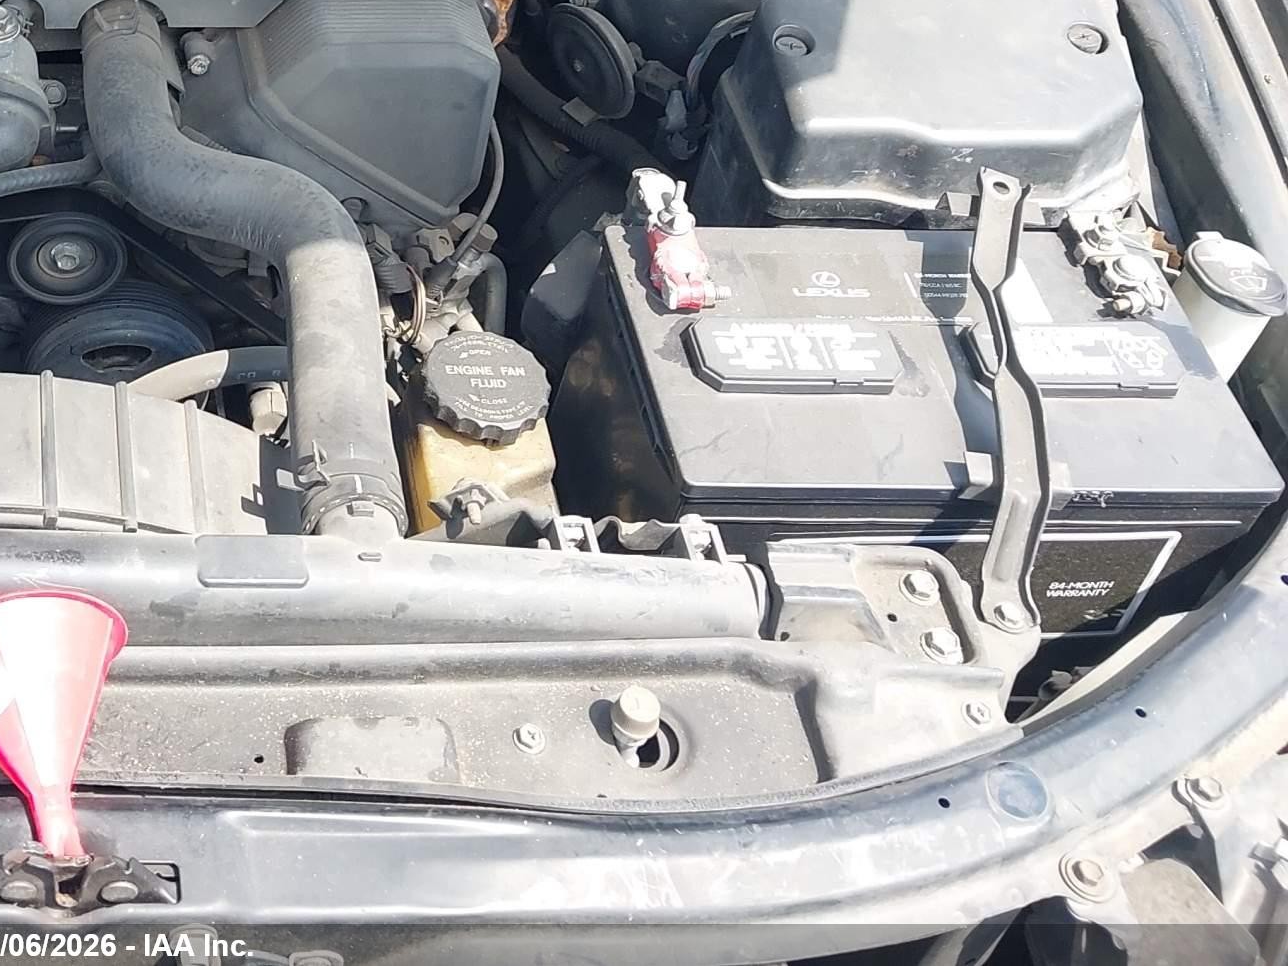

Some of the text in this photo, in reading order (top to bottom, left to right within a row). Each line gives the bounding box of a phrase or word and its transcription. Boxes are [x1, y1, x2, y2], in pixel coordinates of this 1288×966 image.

[792, 287, 872, 298] LEXUS
[445, 365, 526, 377] ENGINE FAN
[470, 378, 508, 388] FLUID
[1048, 581, 1115, 590] 84-MONTH
[1046, 589, 1110, 597] WARRANTY
